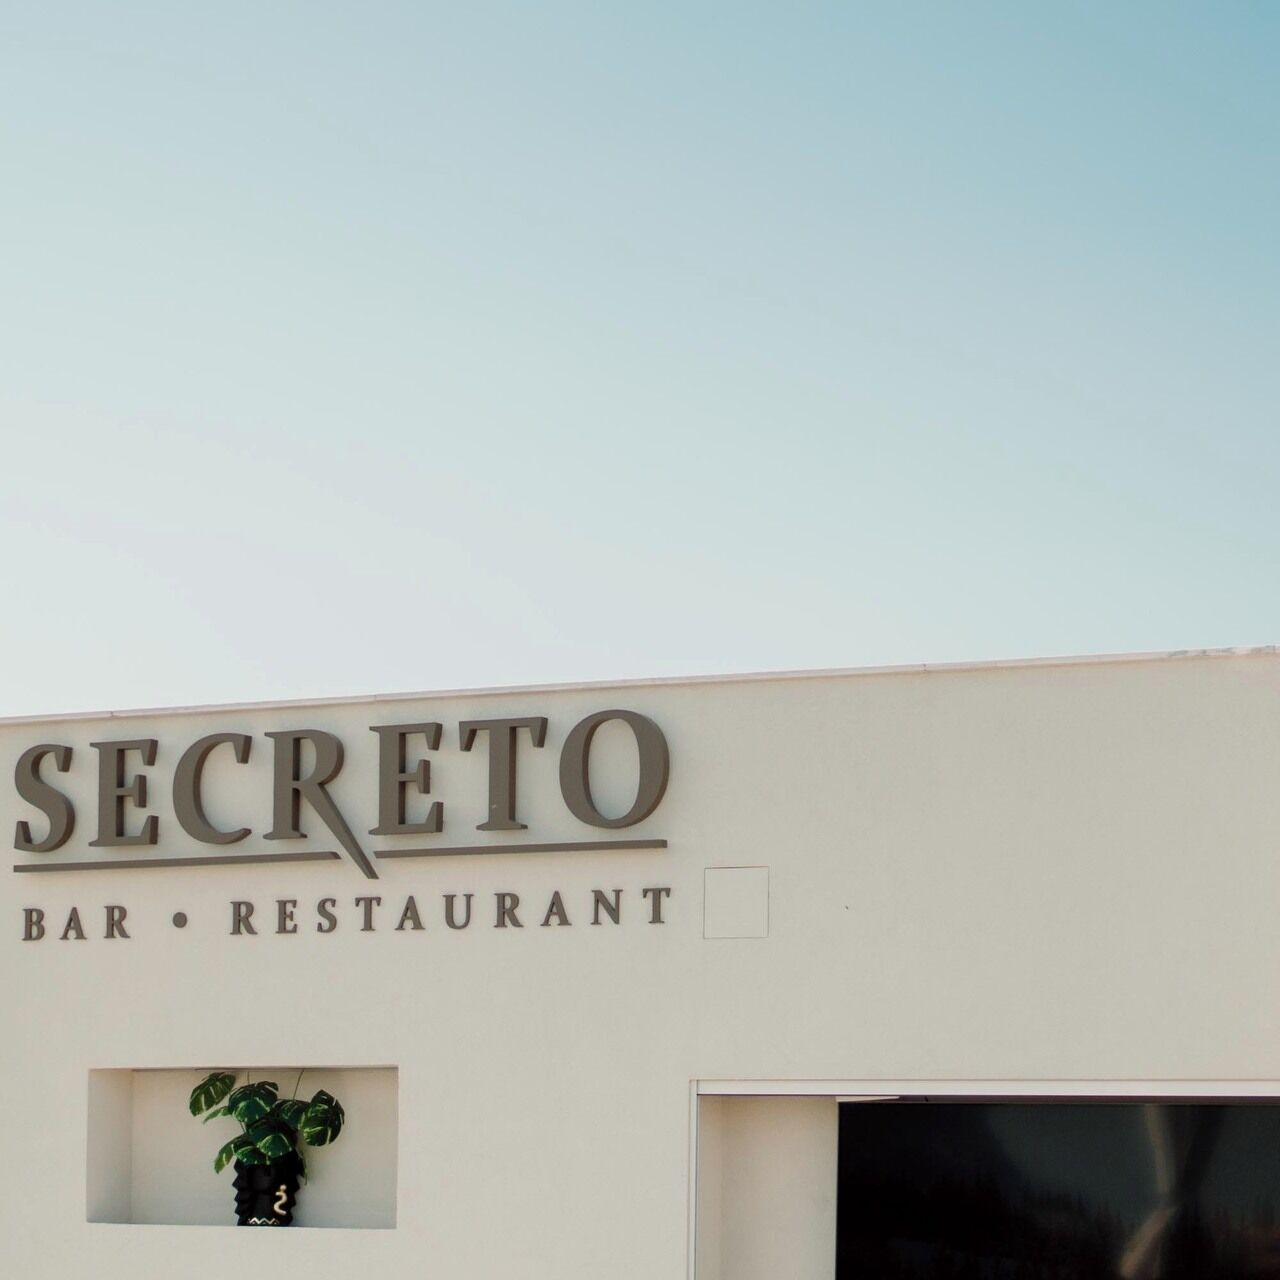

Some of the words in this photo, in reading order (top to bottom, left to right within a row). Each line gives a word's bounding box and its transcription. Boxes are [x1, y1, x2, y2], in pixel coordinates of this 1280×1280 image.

[12, 707, 672, 881] SECRETO
[20, 904, 133, 942] BAR
[227, 886, 673, 936] RESTAURANT
